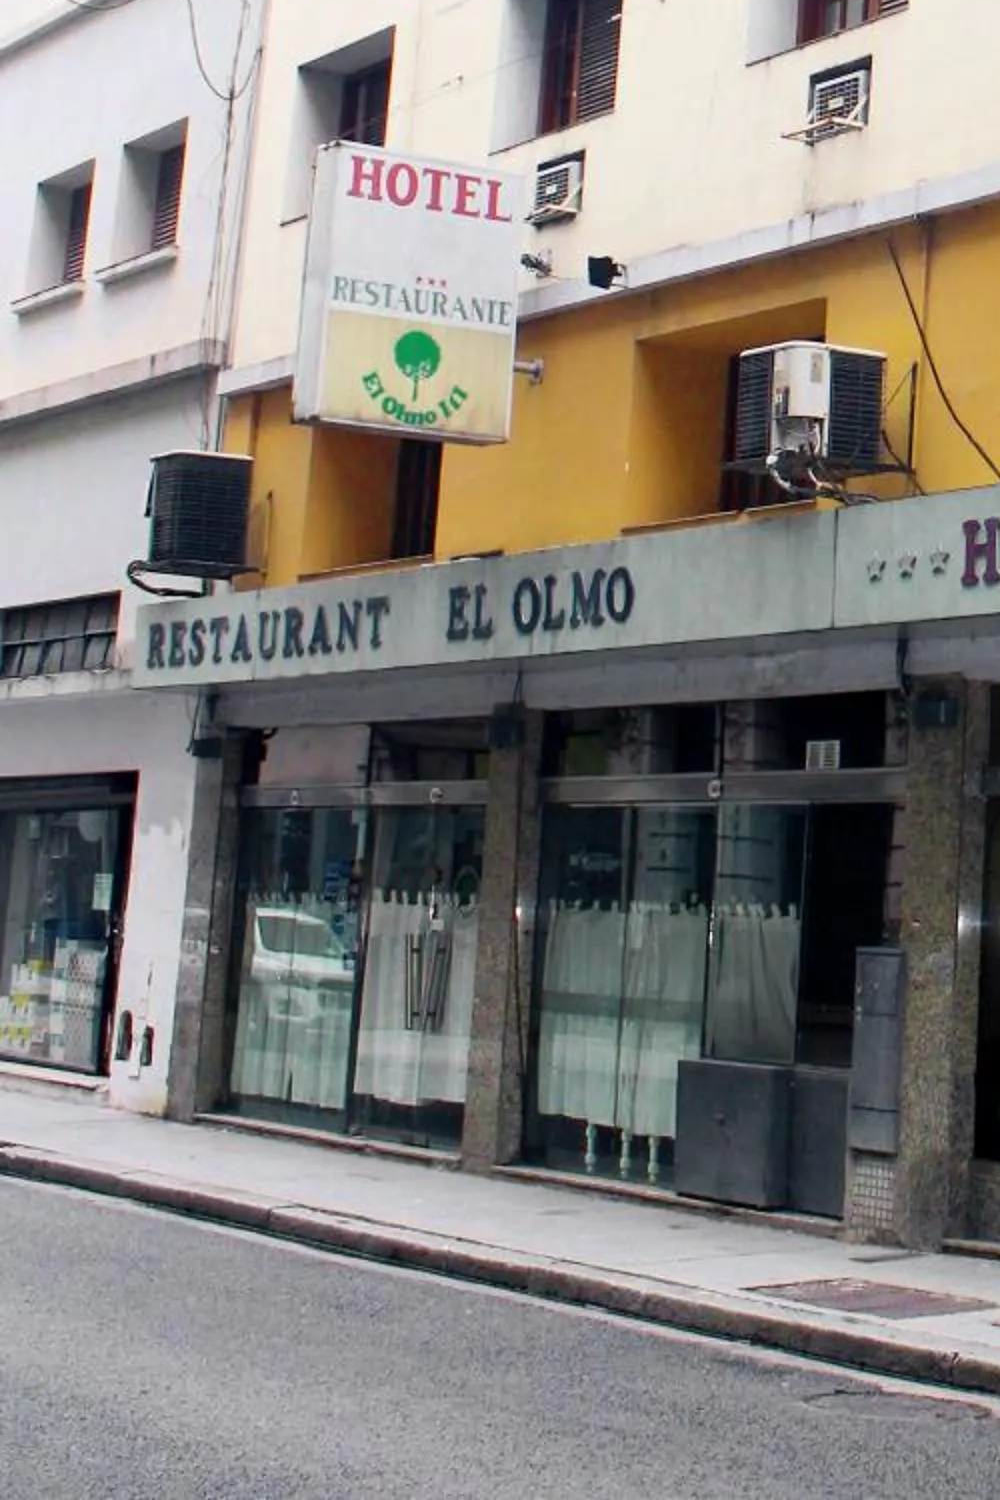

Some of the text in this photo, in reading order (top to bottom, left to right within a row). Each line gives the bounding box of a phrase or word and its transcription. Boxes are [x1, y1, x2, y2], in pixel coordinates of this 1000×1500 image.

[346, 155, 512, 222] HOTEL
[333, 276, 512, 326] RESTAURANTE
[362, 372, 384, 399] El
[382, 397, 437, 424] Olmo
[146, 565, 636, 670] RESTAURANT EL OLMO
